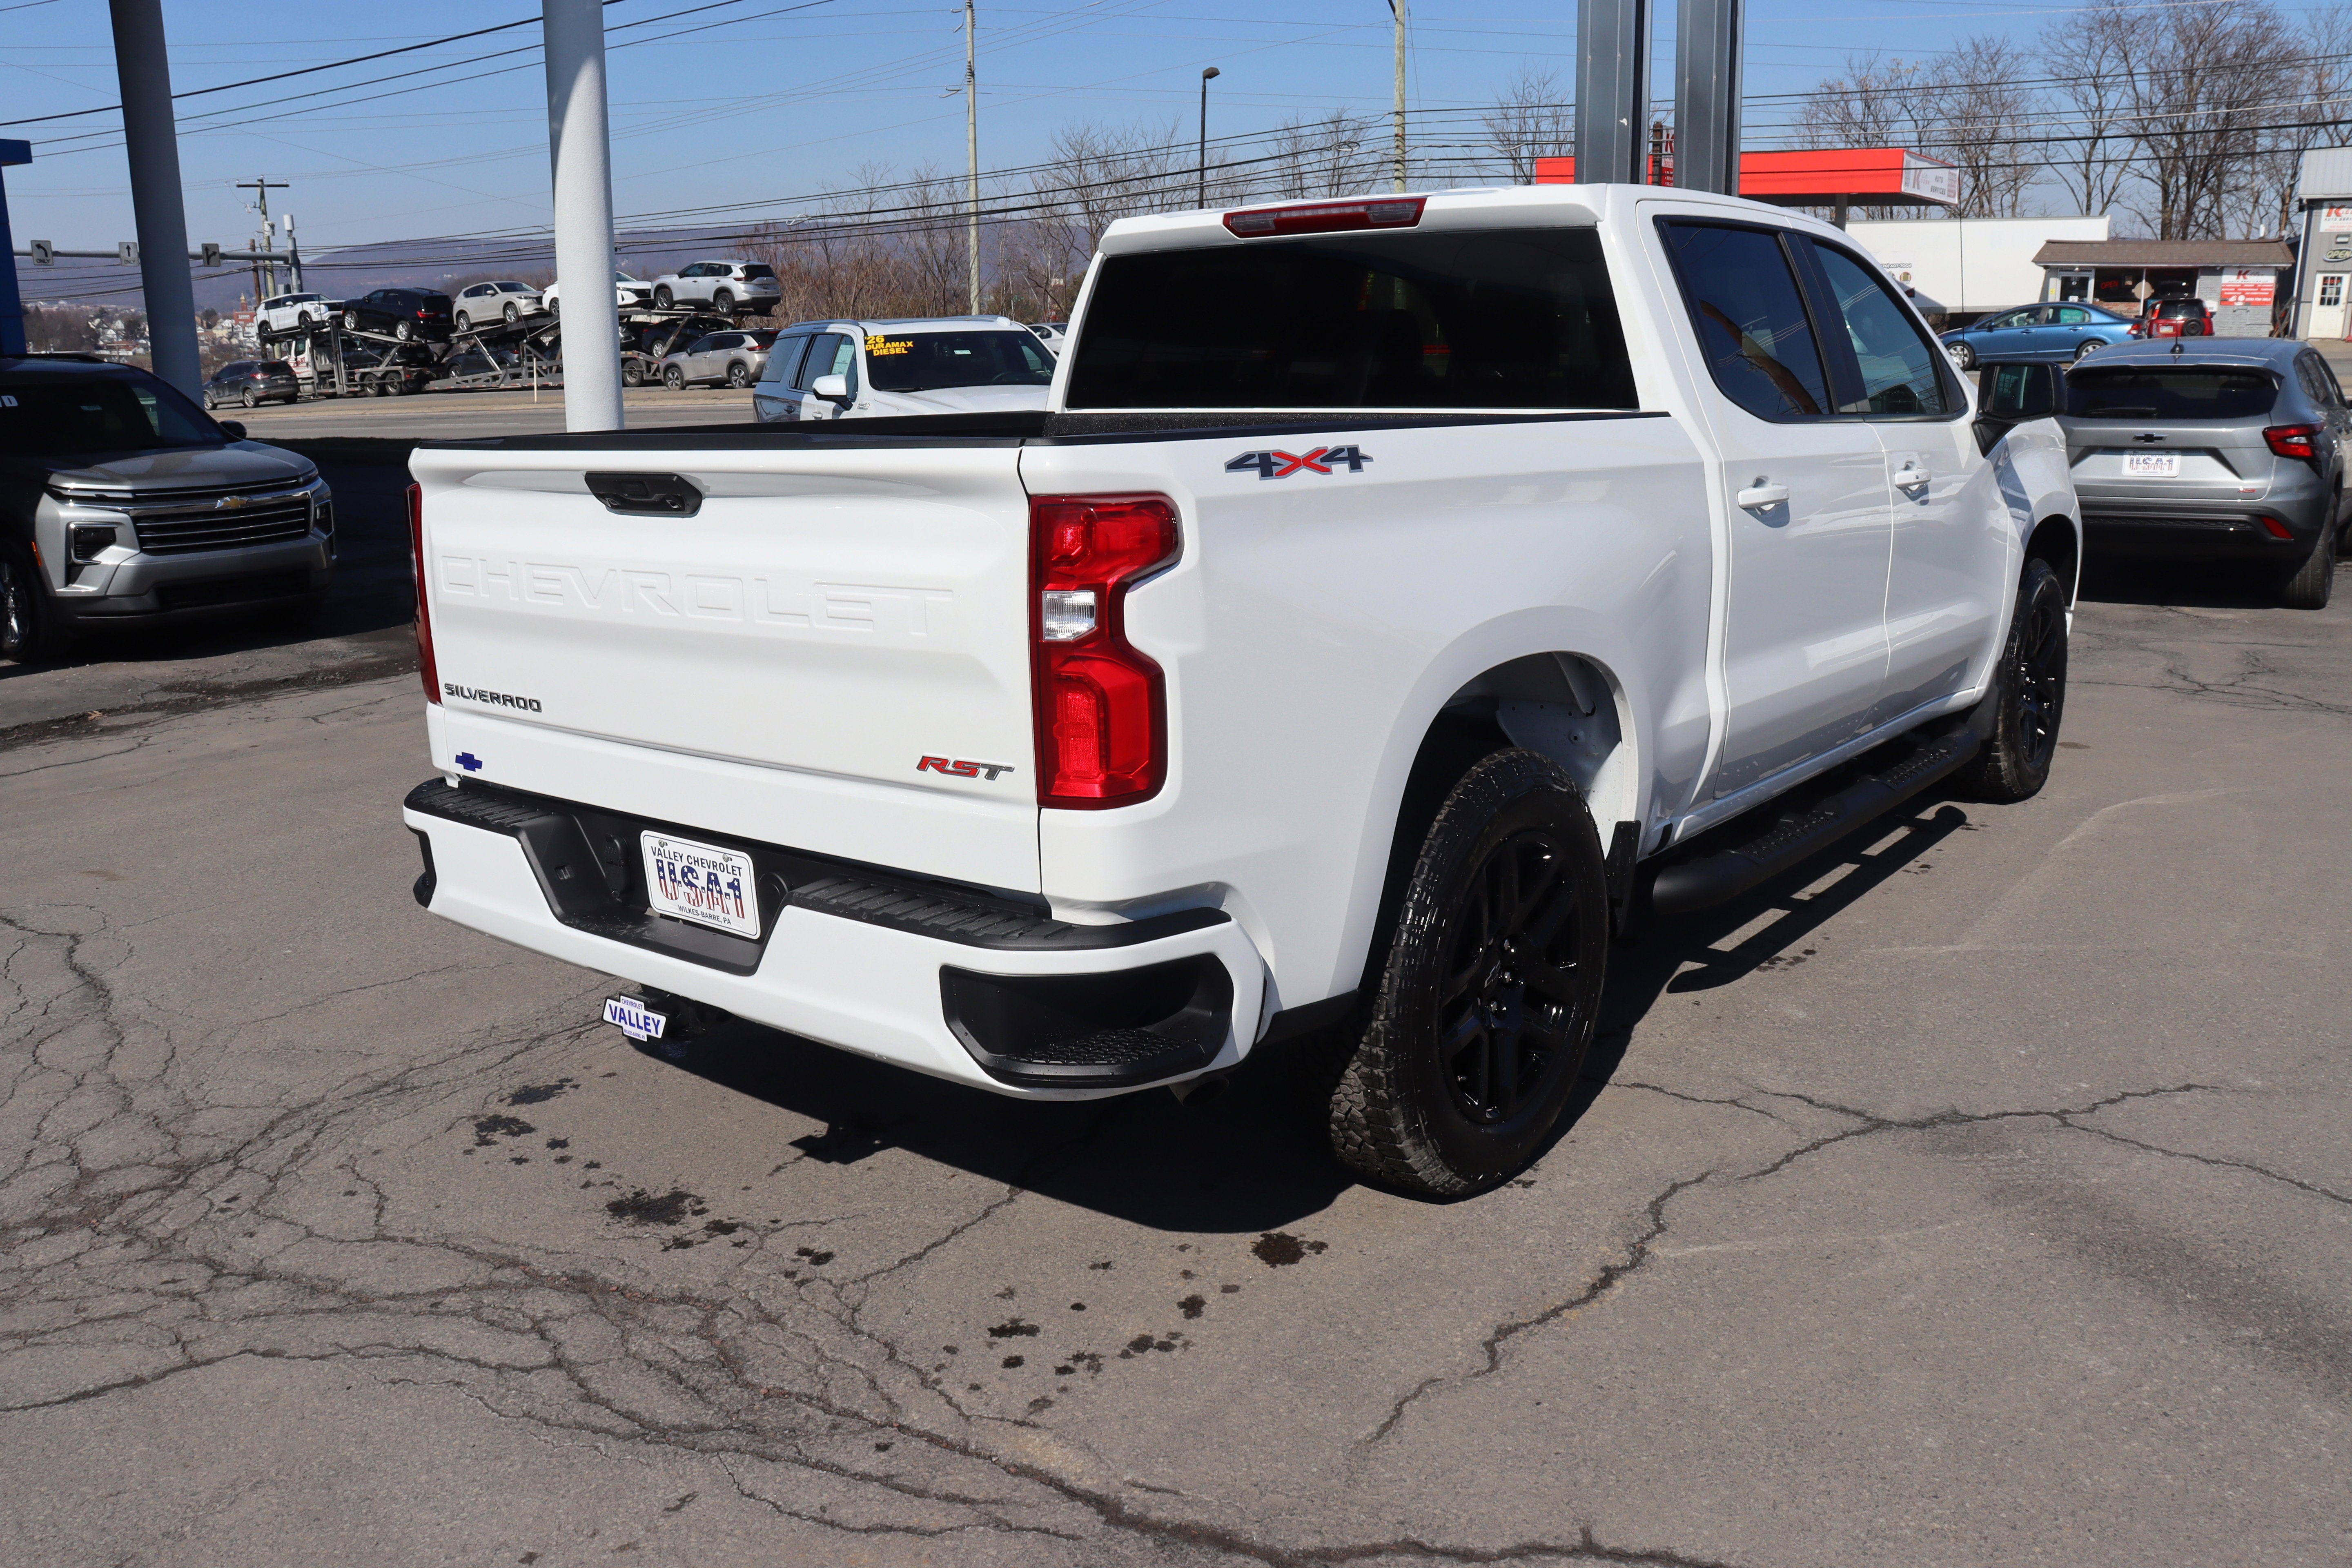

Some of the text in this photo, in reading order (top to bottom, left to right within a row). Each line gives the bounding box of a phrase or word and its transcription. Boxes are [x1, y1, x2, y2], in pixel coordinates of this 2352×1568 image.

[2326, 250, 2351, 258] OPEN
[864, 335, 885, 344] '26
[865, 341, 913, 351] DURAMAX
[873, 347, 908, 356] DIESEL
[0, 395, 18, 407] D
[441, 555, 954, 636] CHEVROLET
[444, 682, 542, 712] SILVERADO
[916, 755, 1015, 781] RST
[650, 846, 742, 877] VALLEY CHEVROLET
[678, 905, 723, 924] WILKES-BARRE,
[621, 998, 643, 1010] CHEVROLET
[608, 1003, 661, 1036] VALLEY
